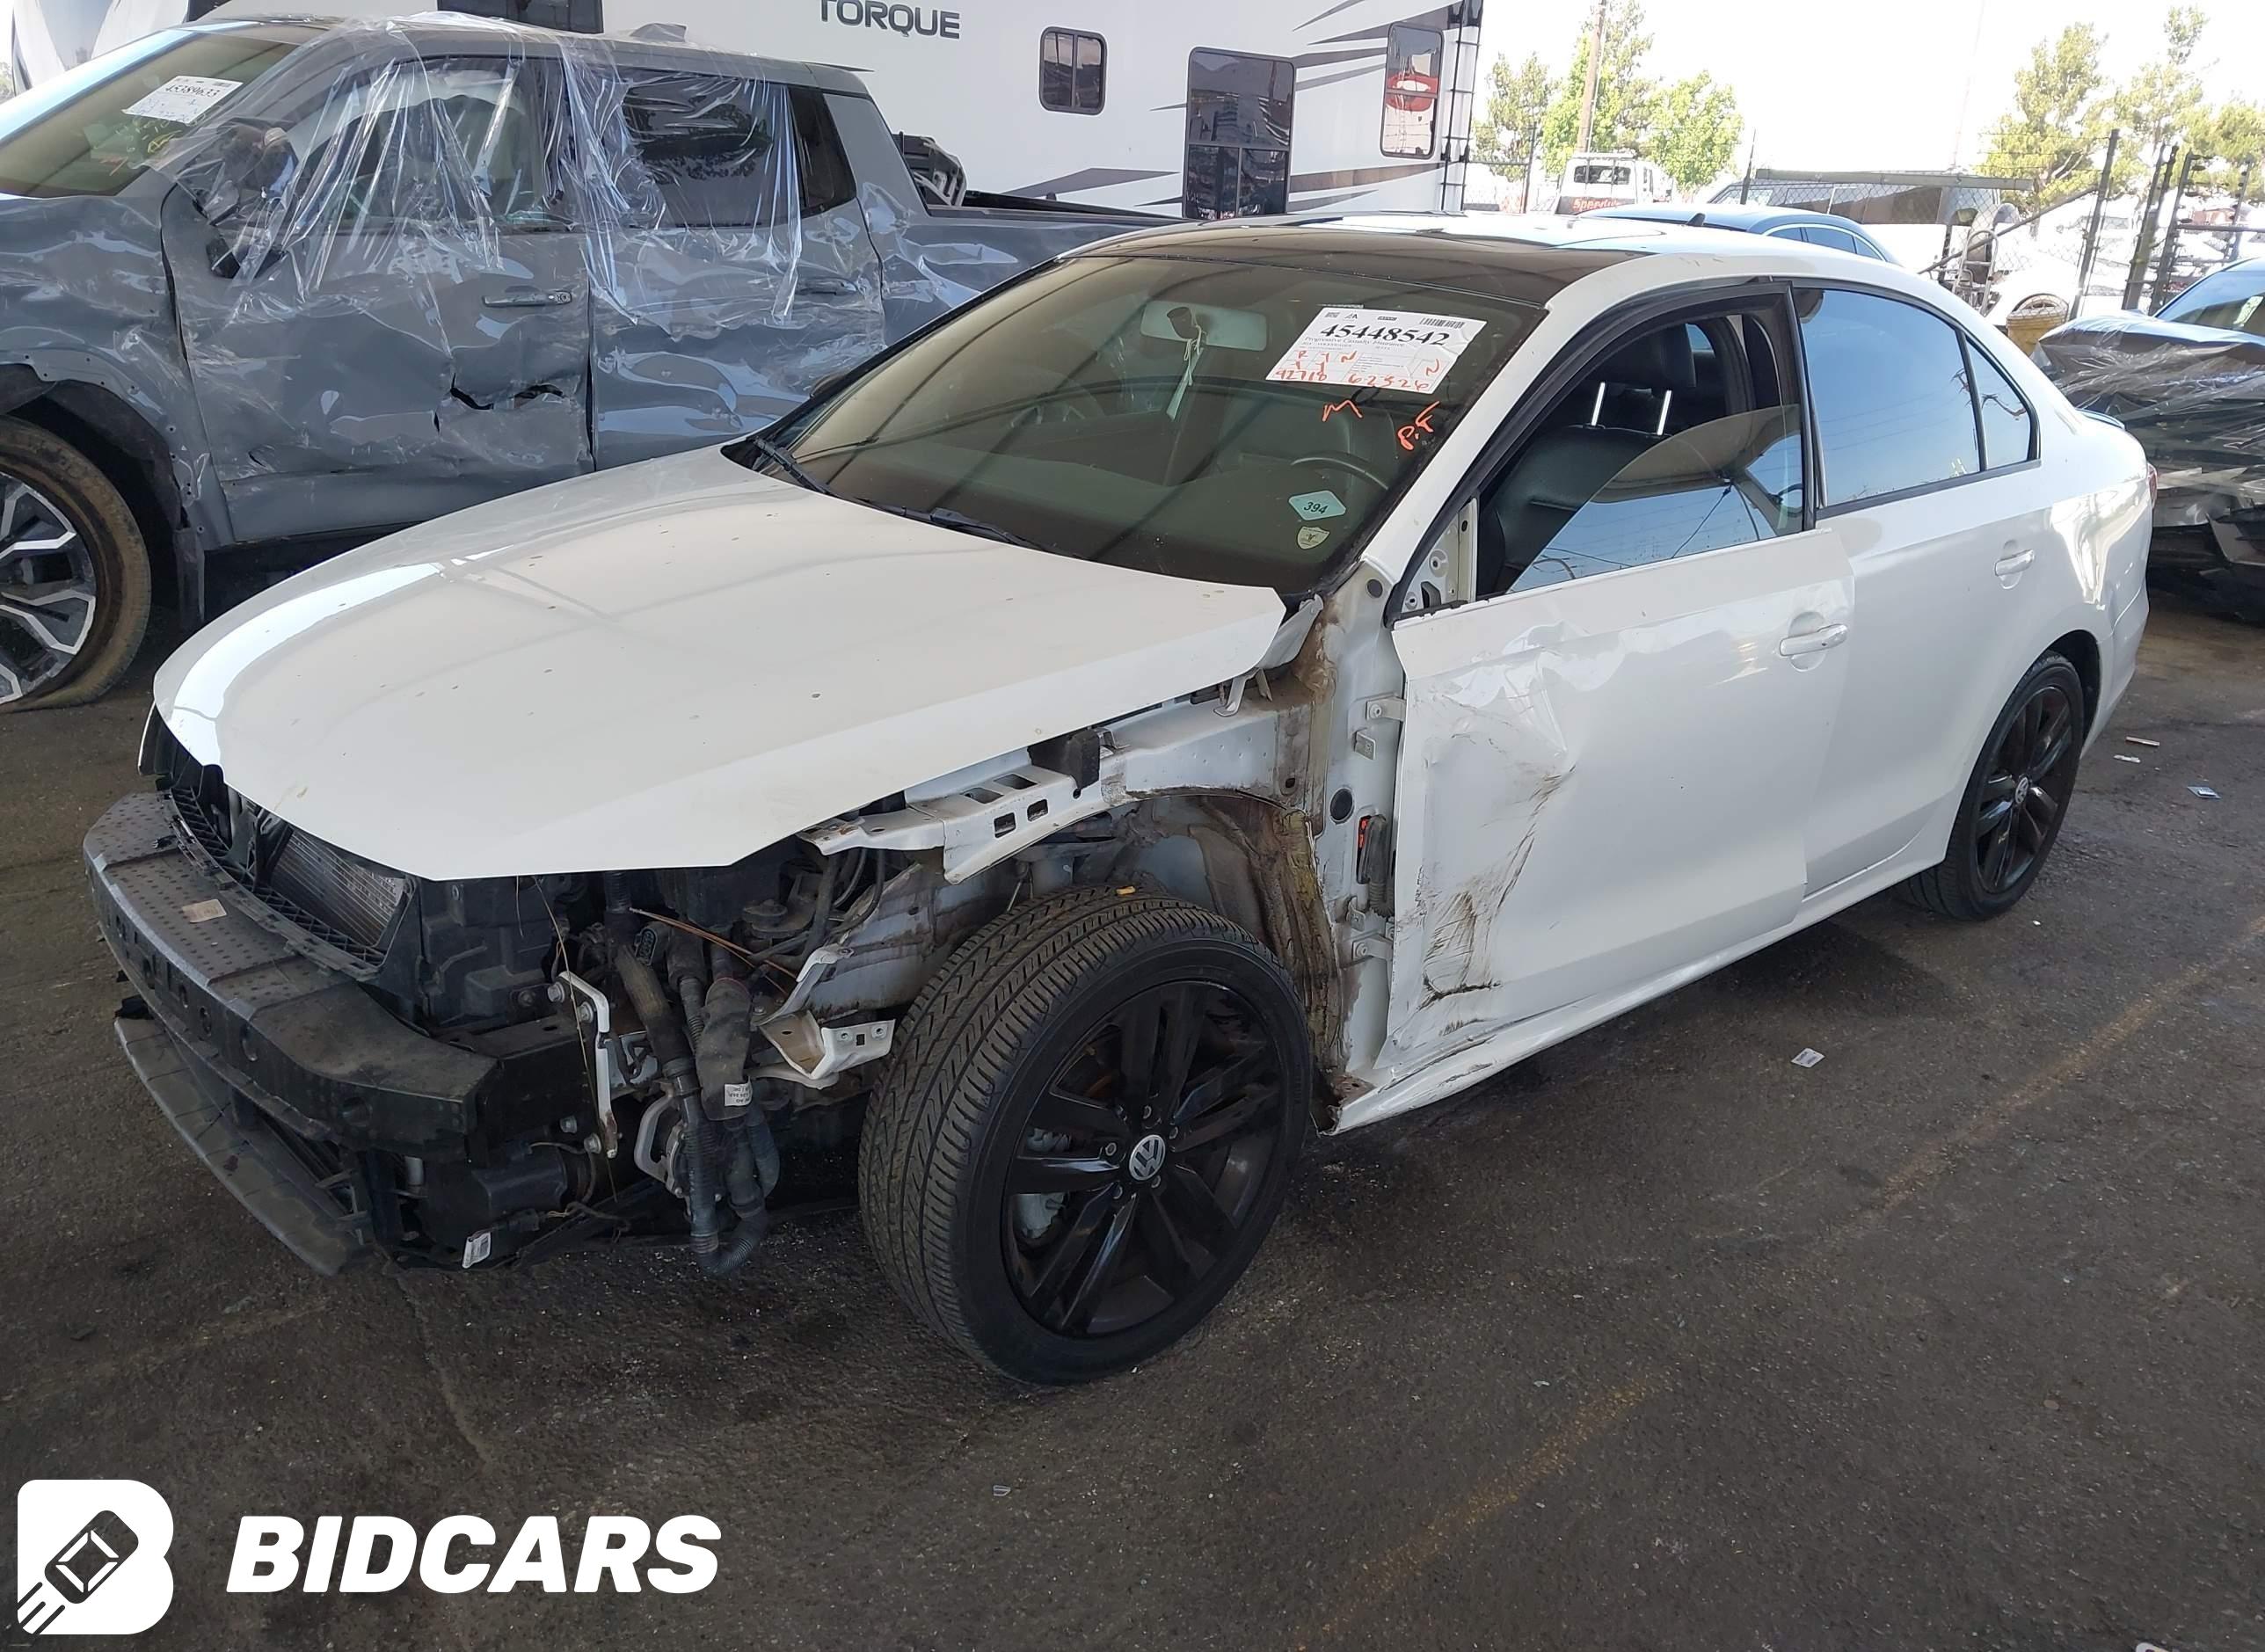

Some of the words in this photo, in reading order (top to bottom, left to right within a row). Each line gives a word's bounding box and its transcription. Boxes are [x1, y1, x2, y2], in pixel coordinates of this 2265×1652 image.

[820, 0, 960, 39] TORQUE
[1320, 323, 1450, 346] 45448542
[1303, 501, 1329, 515] 394
